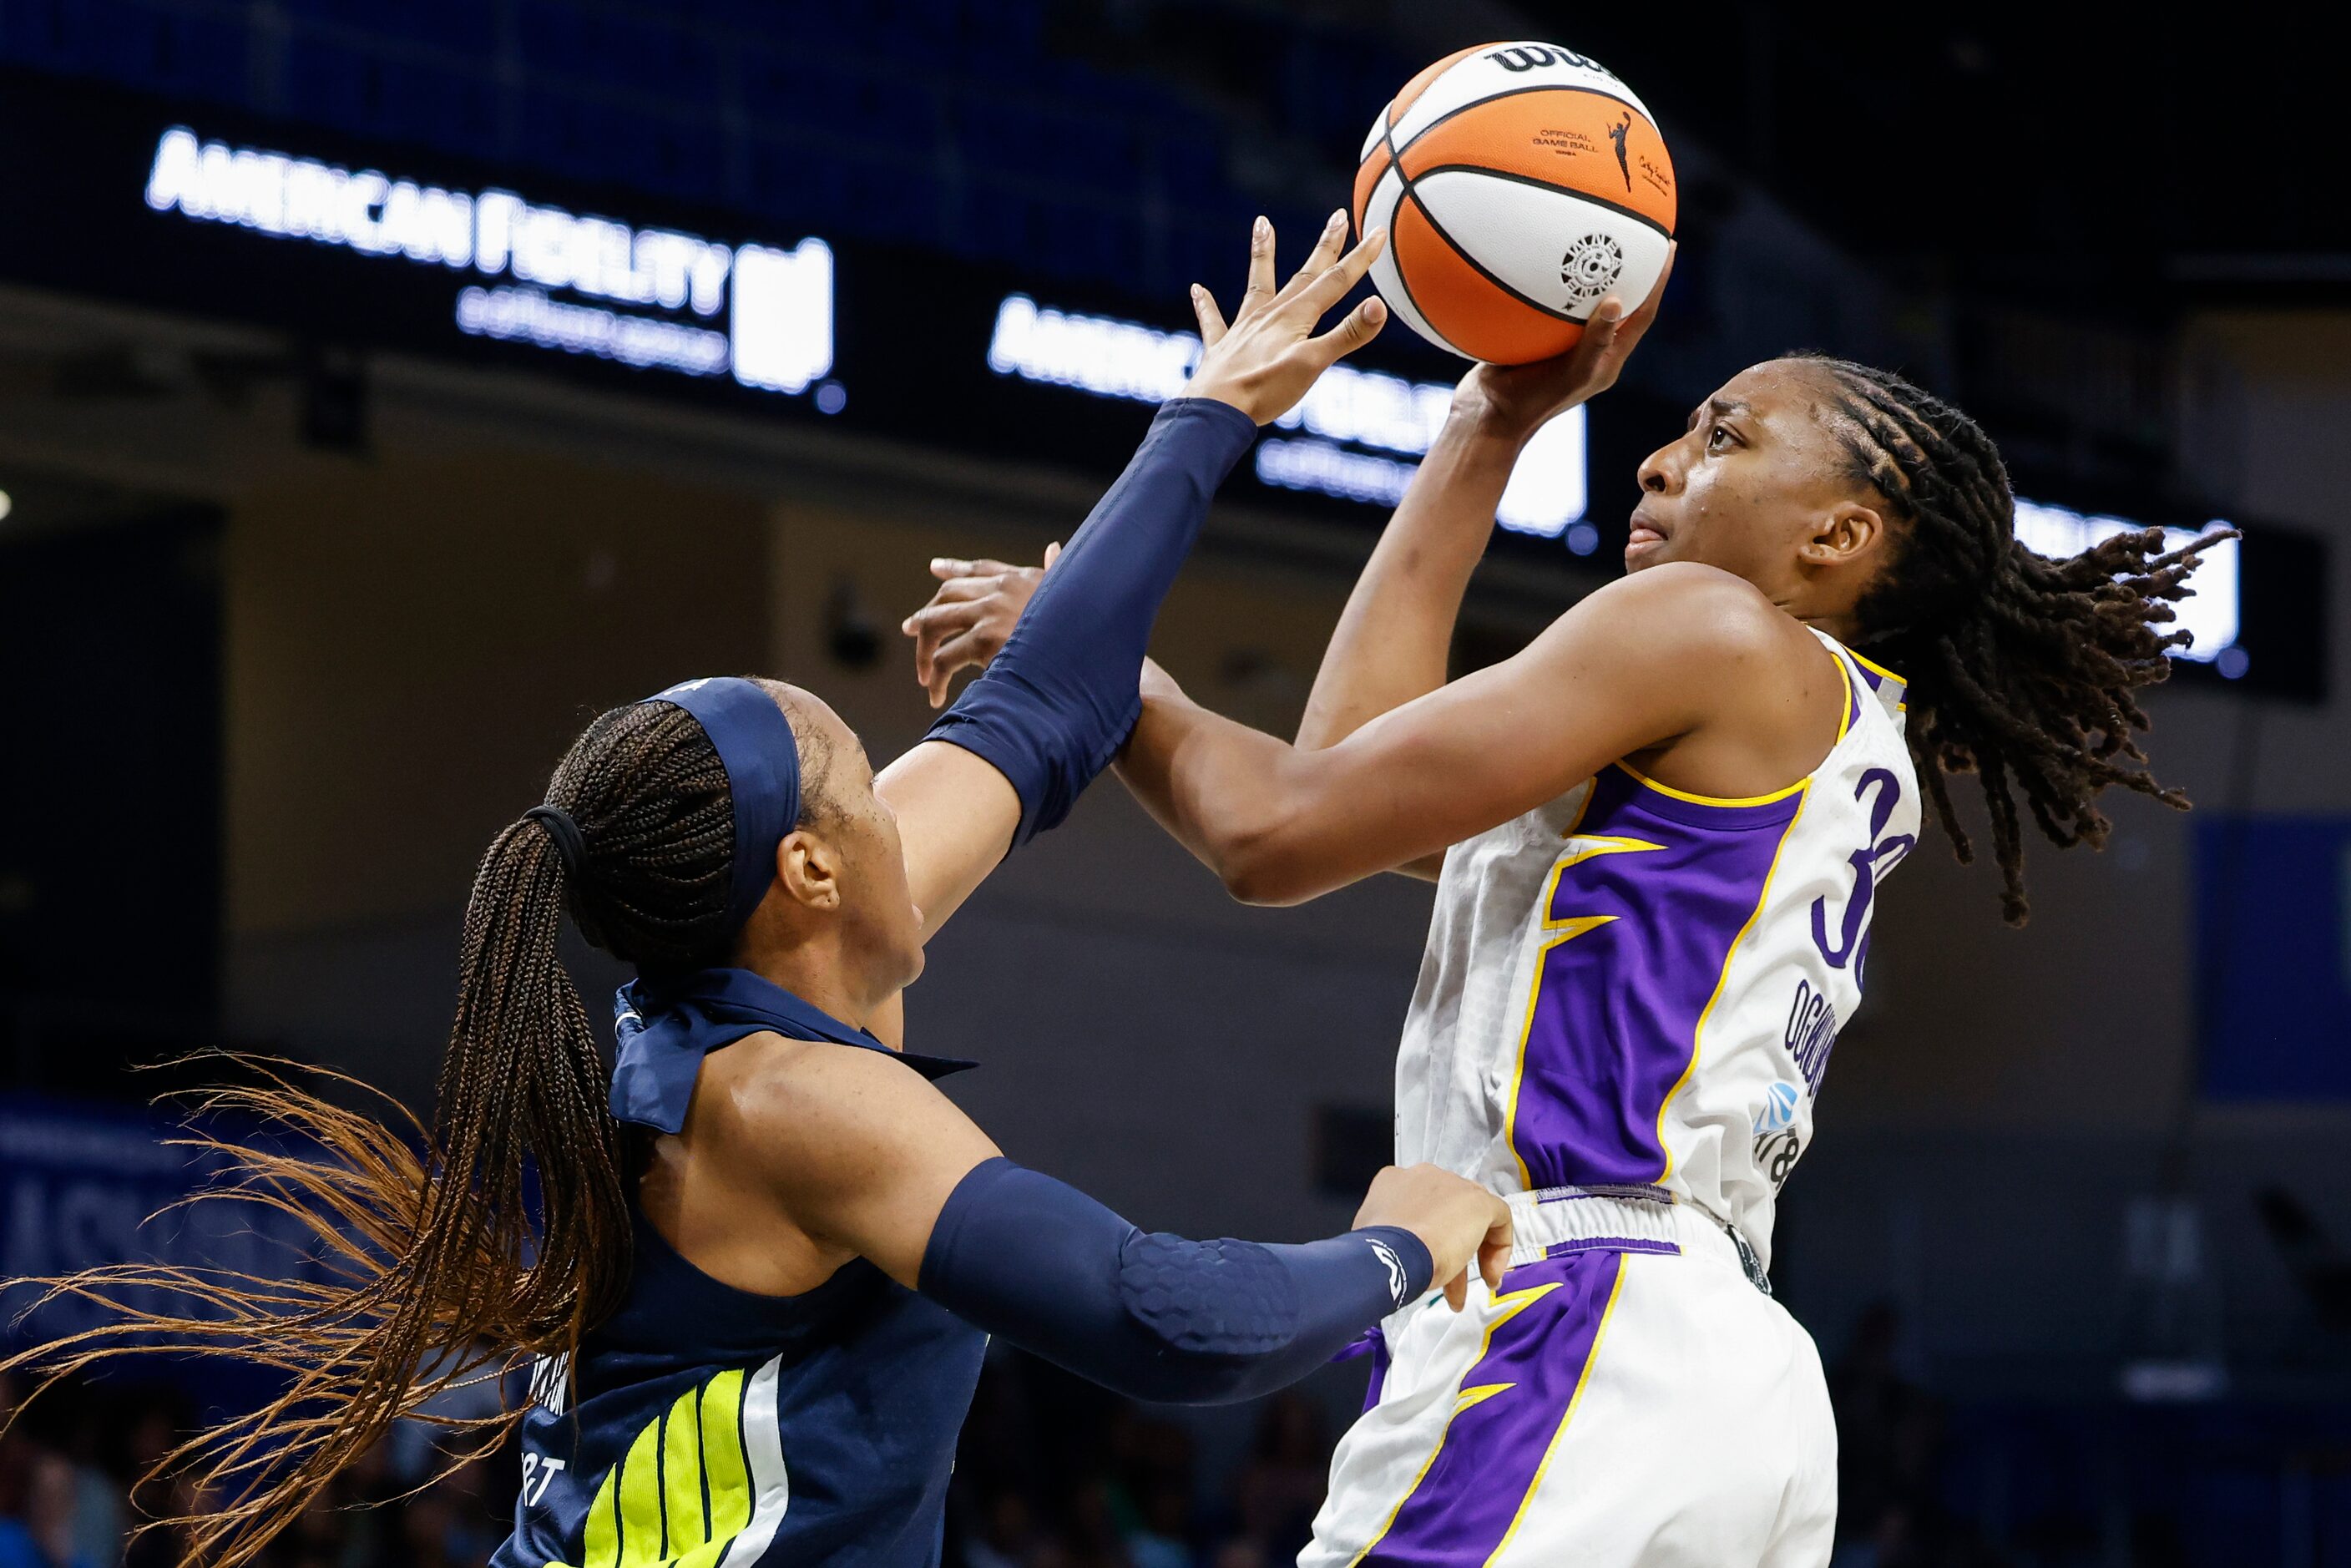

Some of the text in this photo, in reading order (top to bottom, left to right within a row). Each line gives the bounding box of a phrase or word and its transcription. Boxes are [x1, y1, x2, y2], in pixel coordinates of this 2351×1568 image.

[1540, 129, 1591, 143] OFFICIAL
[1532, 138, 1600, 154] GAME BALL
[988, 295, 1204, 404] AMERIC
